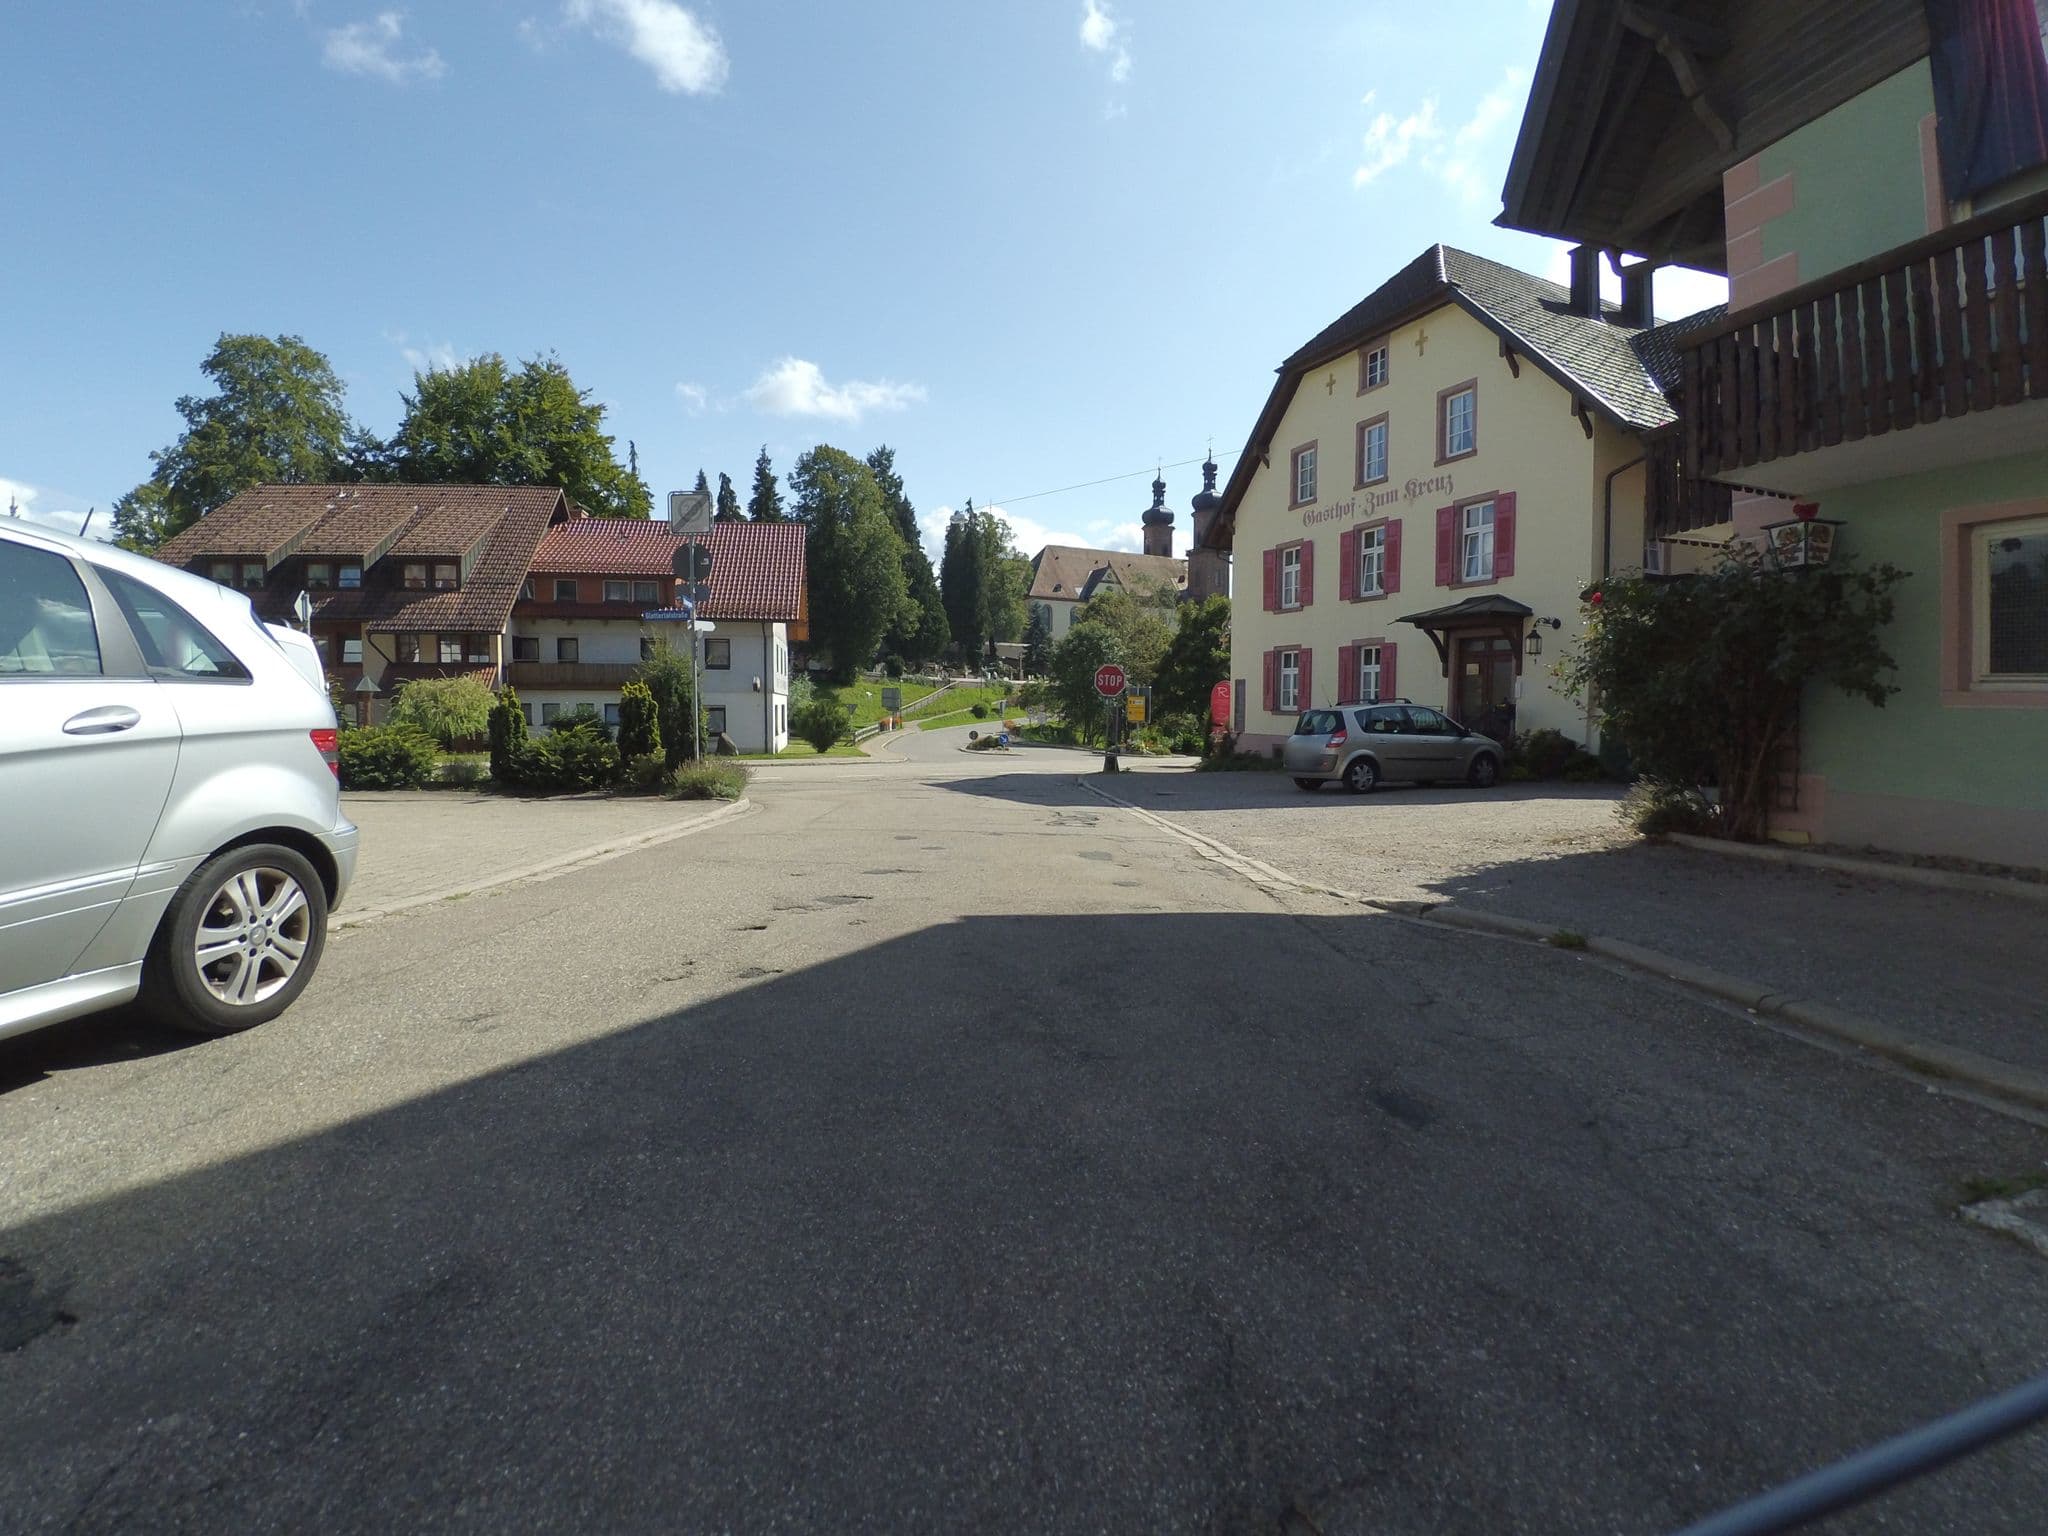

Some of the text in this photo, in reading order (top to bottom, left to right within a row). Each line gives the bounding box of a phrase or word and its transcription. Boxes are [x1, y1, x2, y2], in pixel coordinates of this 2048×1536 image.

[1303, 474, 1454, 527] Gasthof Zum Kreuz
[1097, 674, 1123, 687] STOP
